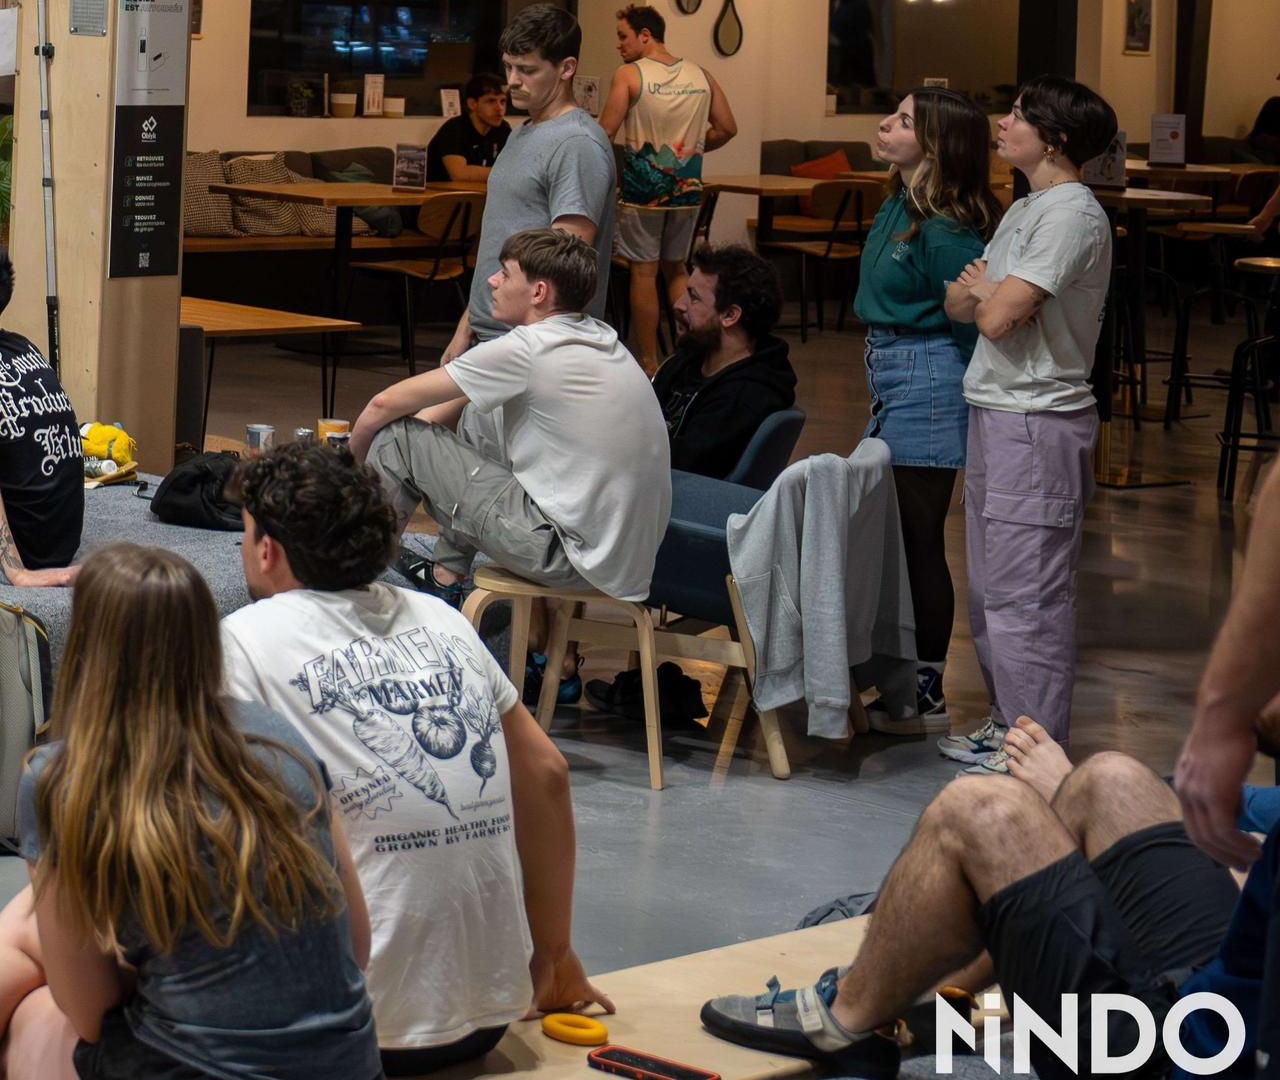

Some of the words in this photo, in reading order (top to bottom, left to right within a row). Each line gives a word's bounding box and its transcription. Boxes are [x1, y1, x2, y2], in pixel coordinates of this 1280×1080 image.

[125, 4, 140, 12] EST
[374, 828, 440, 844] ORGANIC
[444, 819, 489, 836] HEALTHY
[375, 838, 438, 853] GROWN
[445, 835, 461, 845] BY
